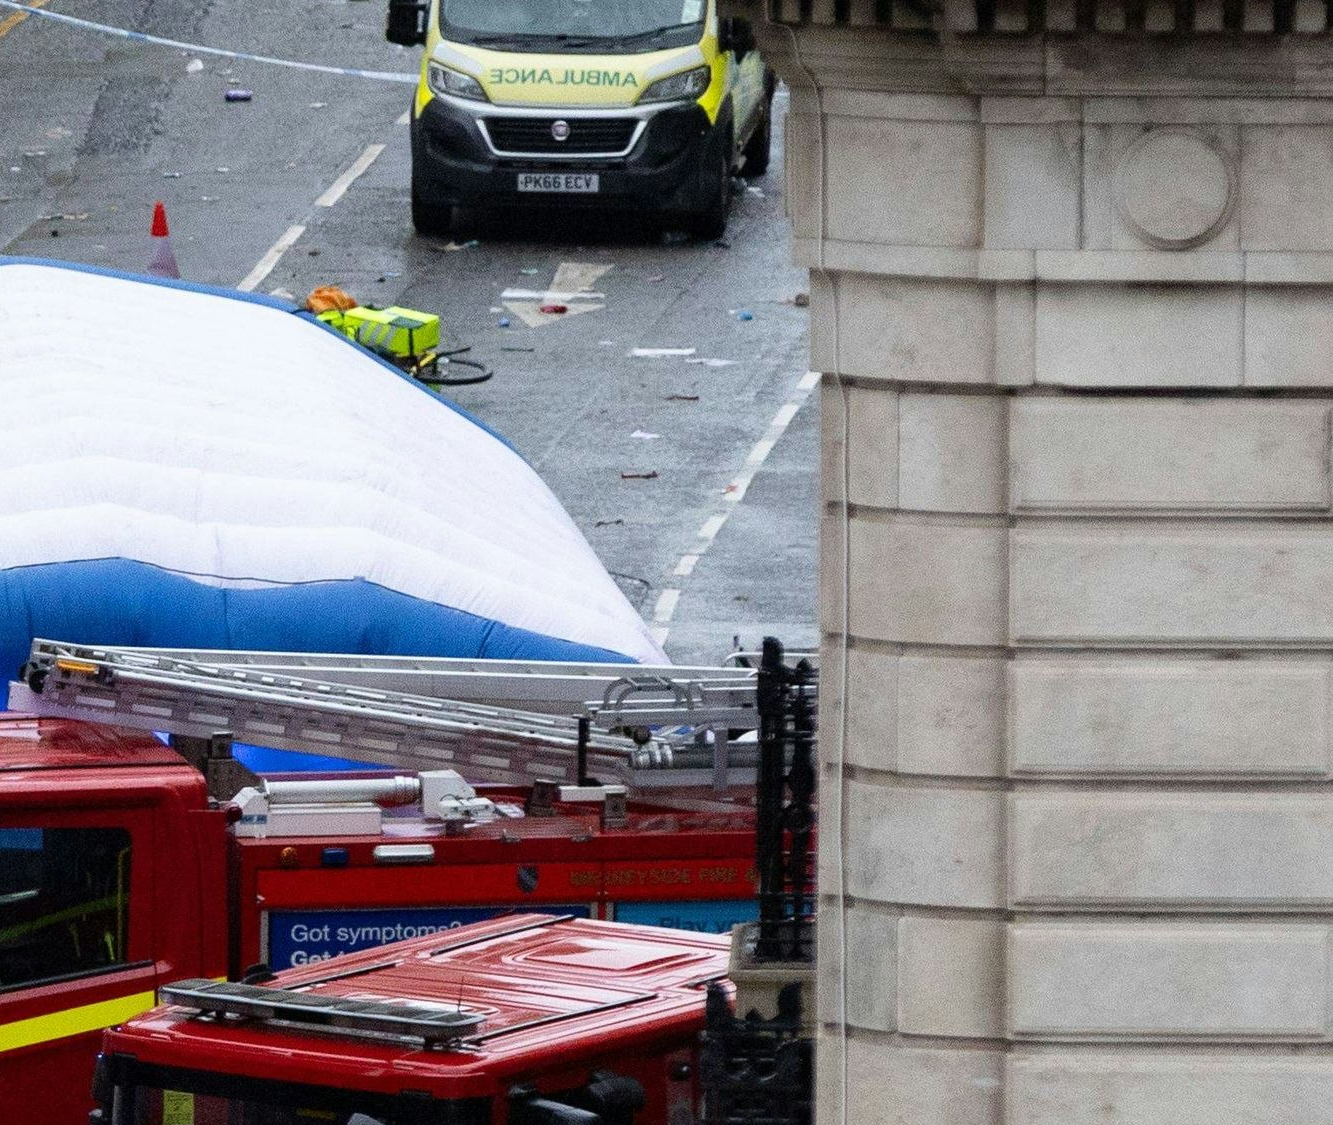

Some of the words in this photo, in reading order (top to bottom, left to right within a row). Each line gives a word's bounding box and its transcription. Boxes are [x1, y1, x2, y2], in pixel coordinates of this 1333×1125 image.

[524, 176, 561, 189] PK66
[565, 176, 593, 189] ECV
[290, 924, 331, 942] Got
